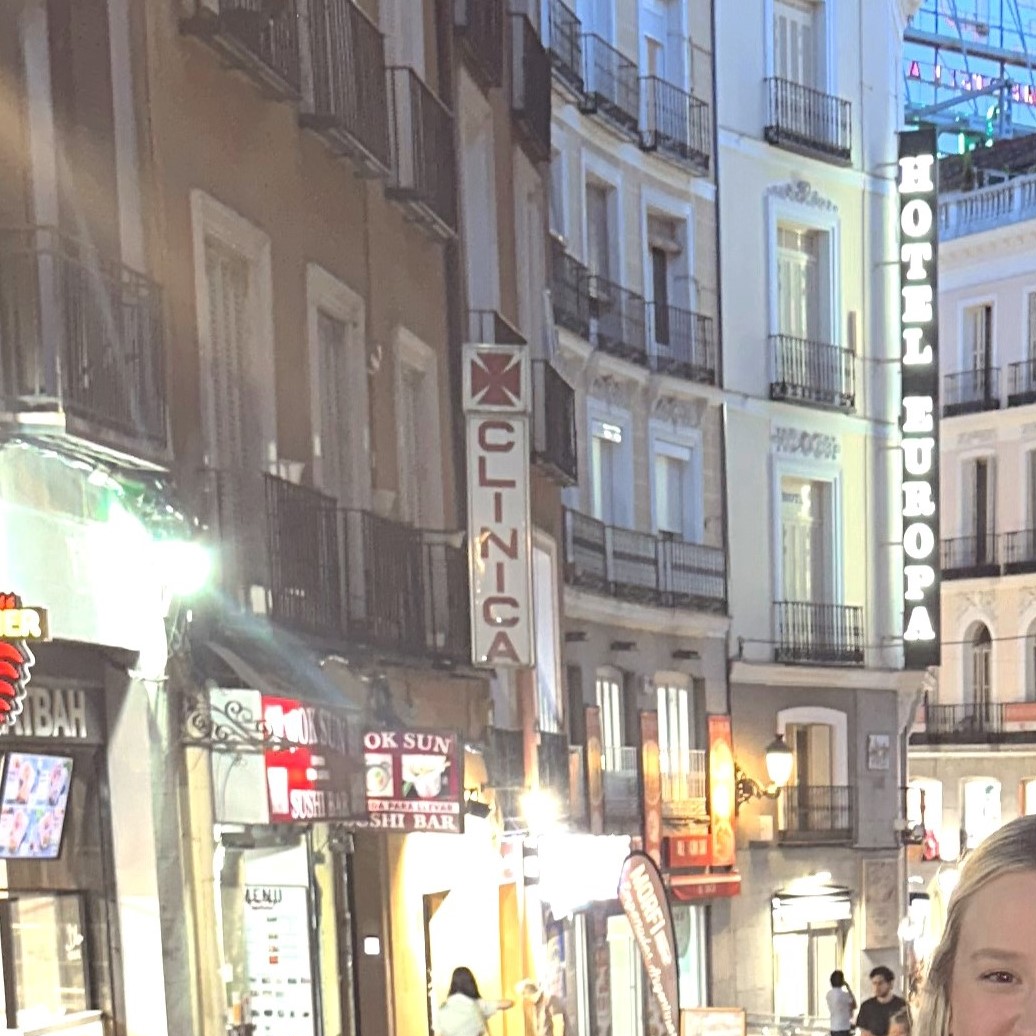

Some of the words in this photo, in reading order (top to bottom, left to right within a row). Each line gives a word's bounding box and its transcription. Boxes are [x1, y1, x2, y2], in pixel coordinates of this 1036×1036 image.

[898, 154, 934, 366] HOTEL
[477, 420, 521, 664] CLINICA
[902, 396, 936, 641] EUROPA
[0, 608, 41, 638] ER
[1, 686, 88, 738] IBAH
[403, 732, 451, 754] SUN
[290, 788, 326, 819] SUSHI
[413, 813, 458, 831] BAR
[629, 863, 666, 936] MORFI
